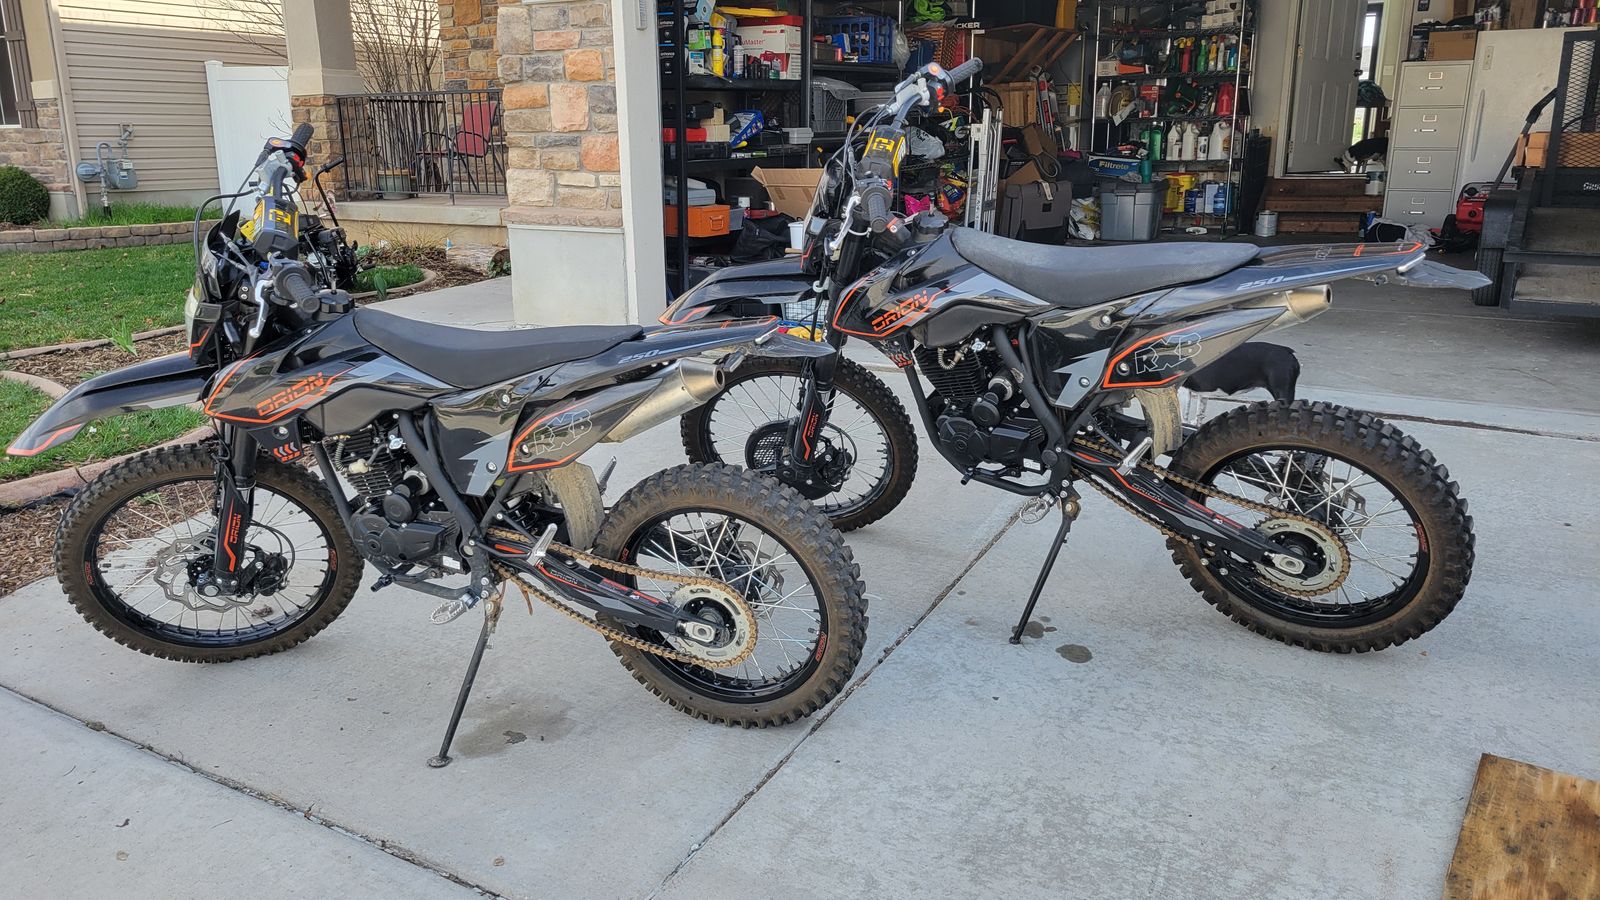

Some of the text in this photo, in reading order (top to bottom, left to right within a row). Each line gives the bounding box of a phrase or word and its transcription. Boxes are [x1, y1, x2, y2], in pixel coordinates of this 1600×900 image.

[1236, 276, 1284, 291] 250
[871, 289, 928, 332] ORION
[618, 350, 660, 364] 250
[255, 371, 324, 417] ORION
[1132, 483, 1164, 501] ORION
[229, 513, 242, 544] ORION
[550, 569, 578, 585] ORION
